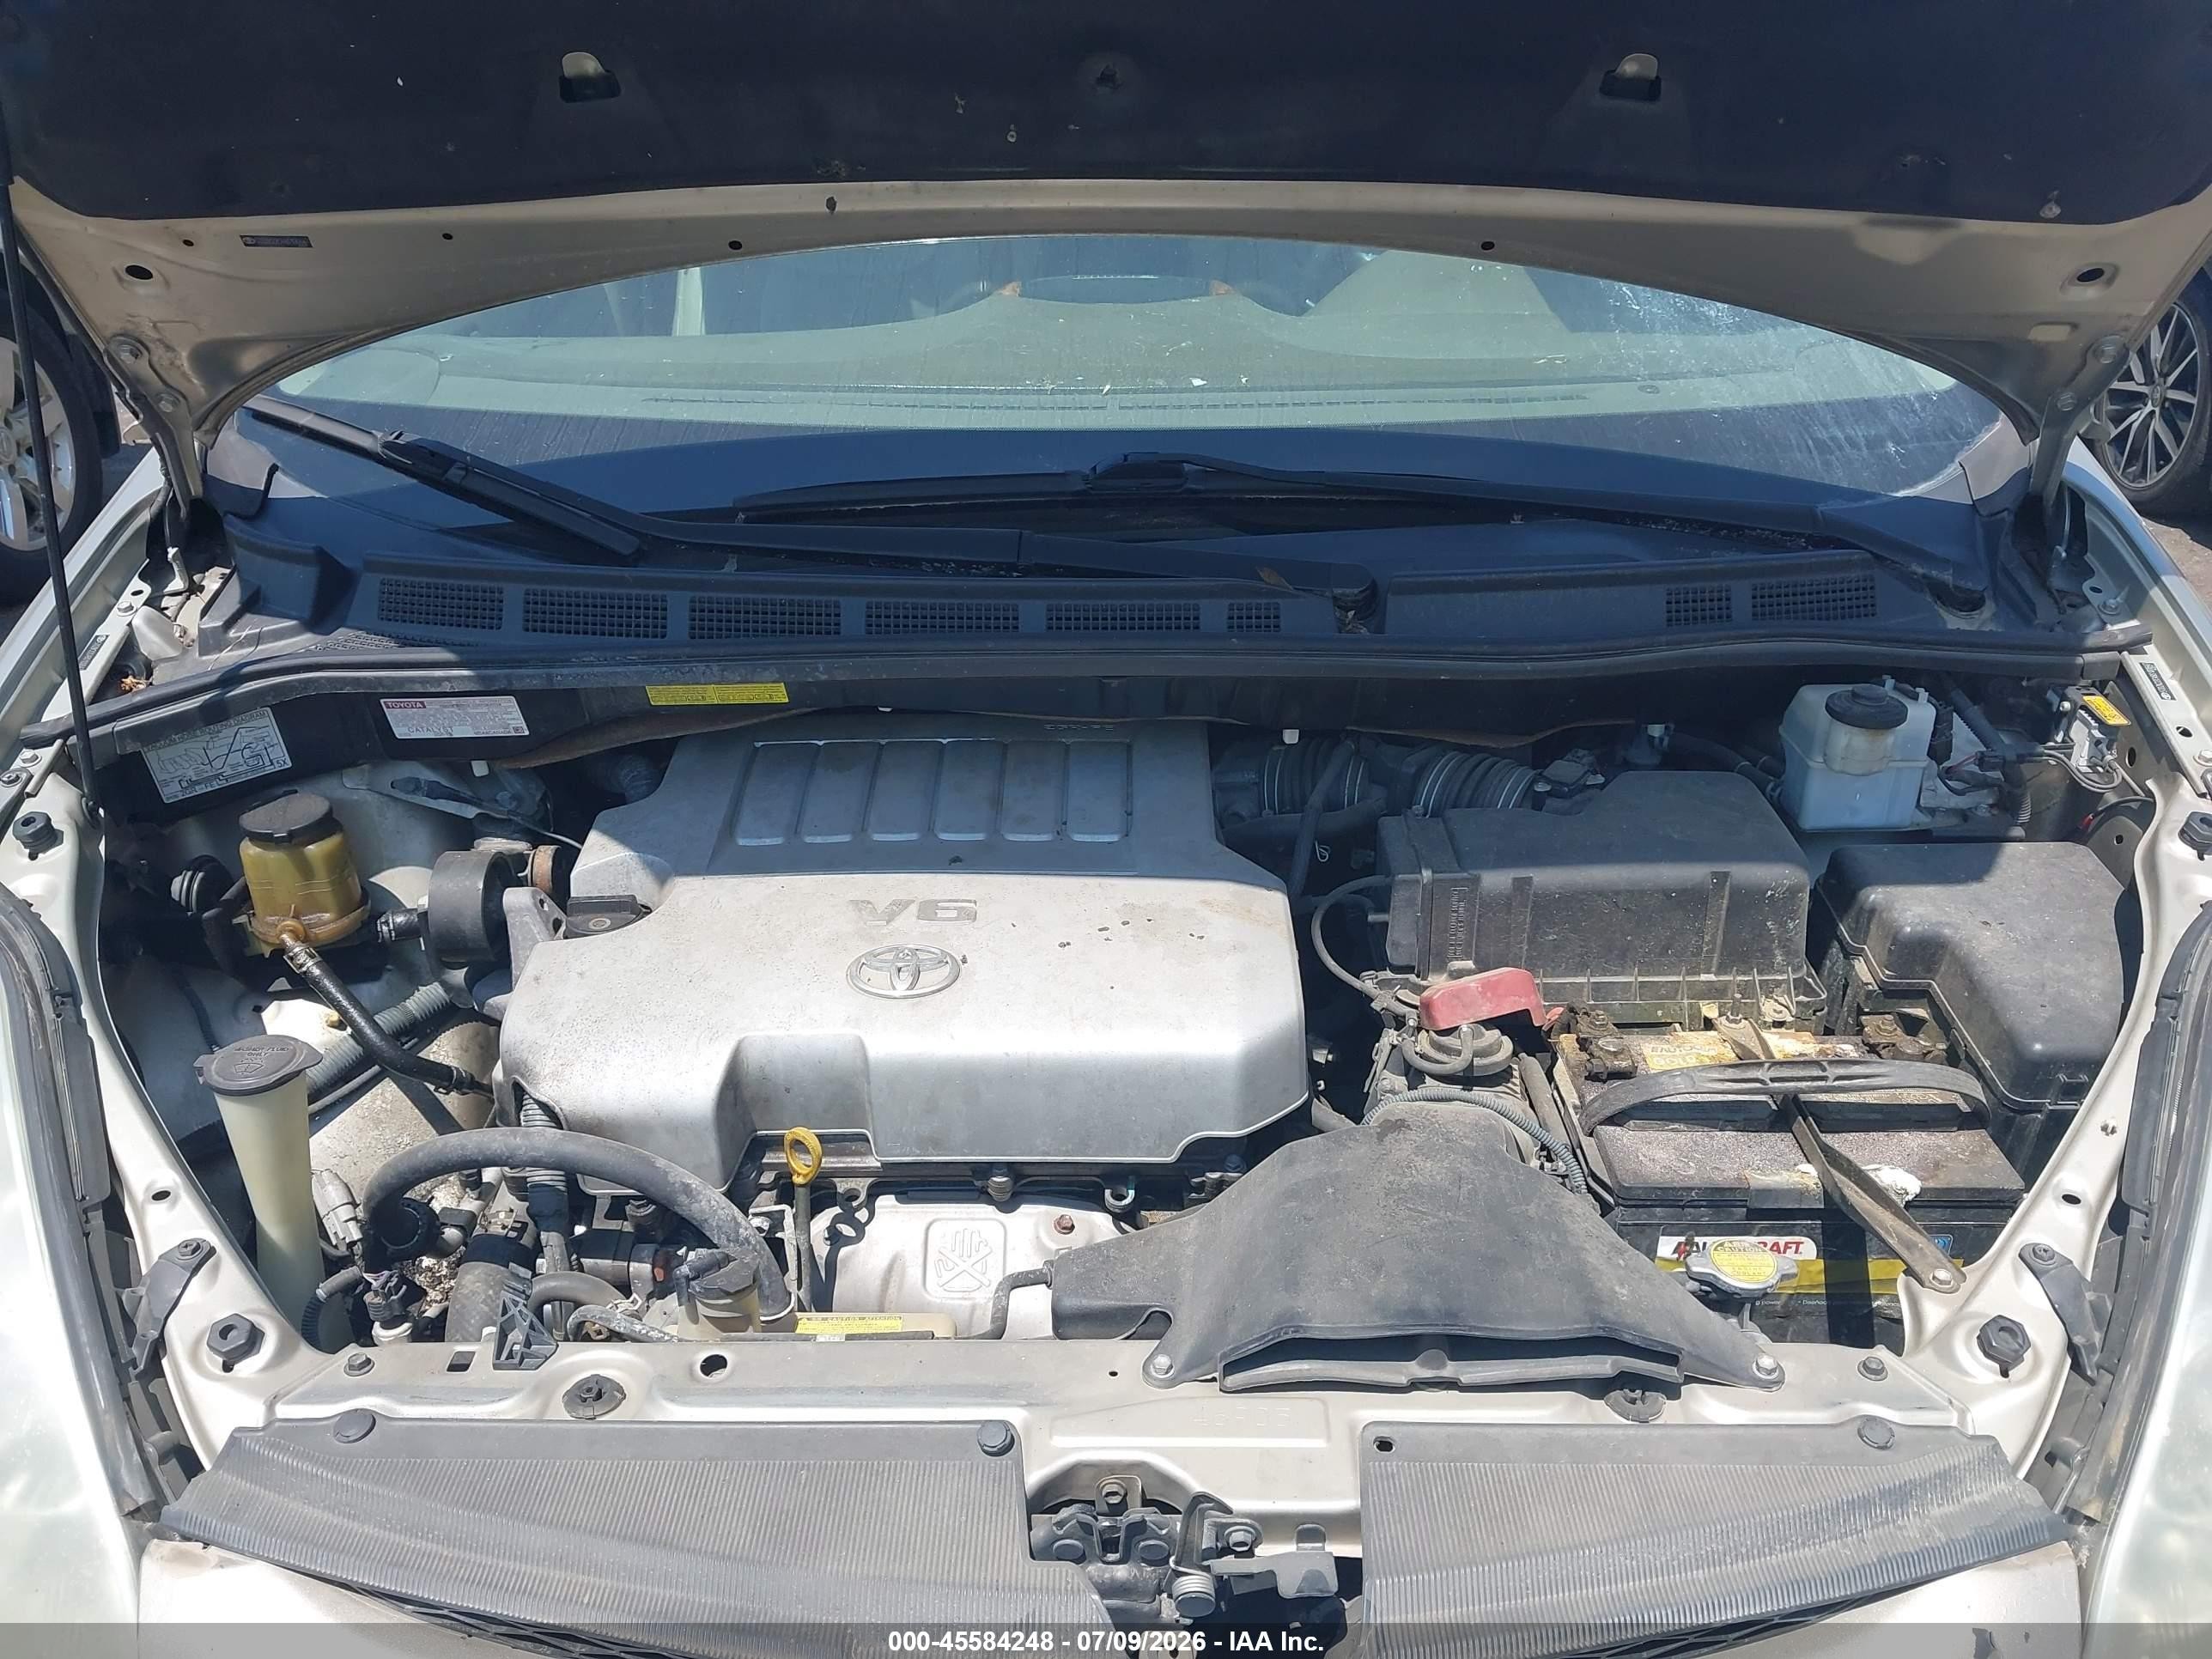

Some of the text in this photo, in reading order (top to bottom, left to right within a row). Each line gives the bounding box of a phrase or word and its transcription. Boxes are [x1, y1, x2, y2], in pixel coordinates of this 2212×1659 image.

[233, 711, 266, 726] DIAGRAM
[407, 726, 453, 734] CATALYST
[848, 899, 978, 927] V6
